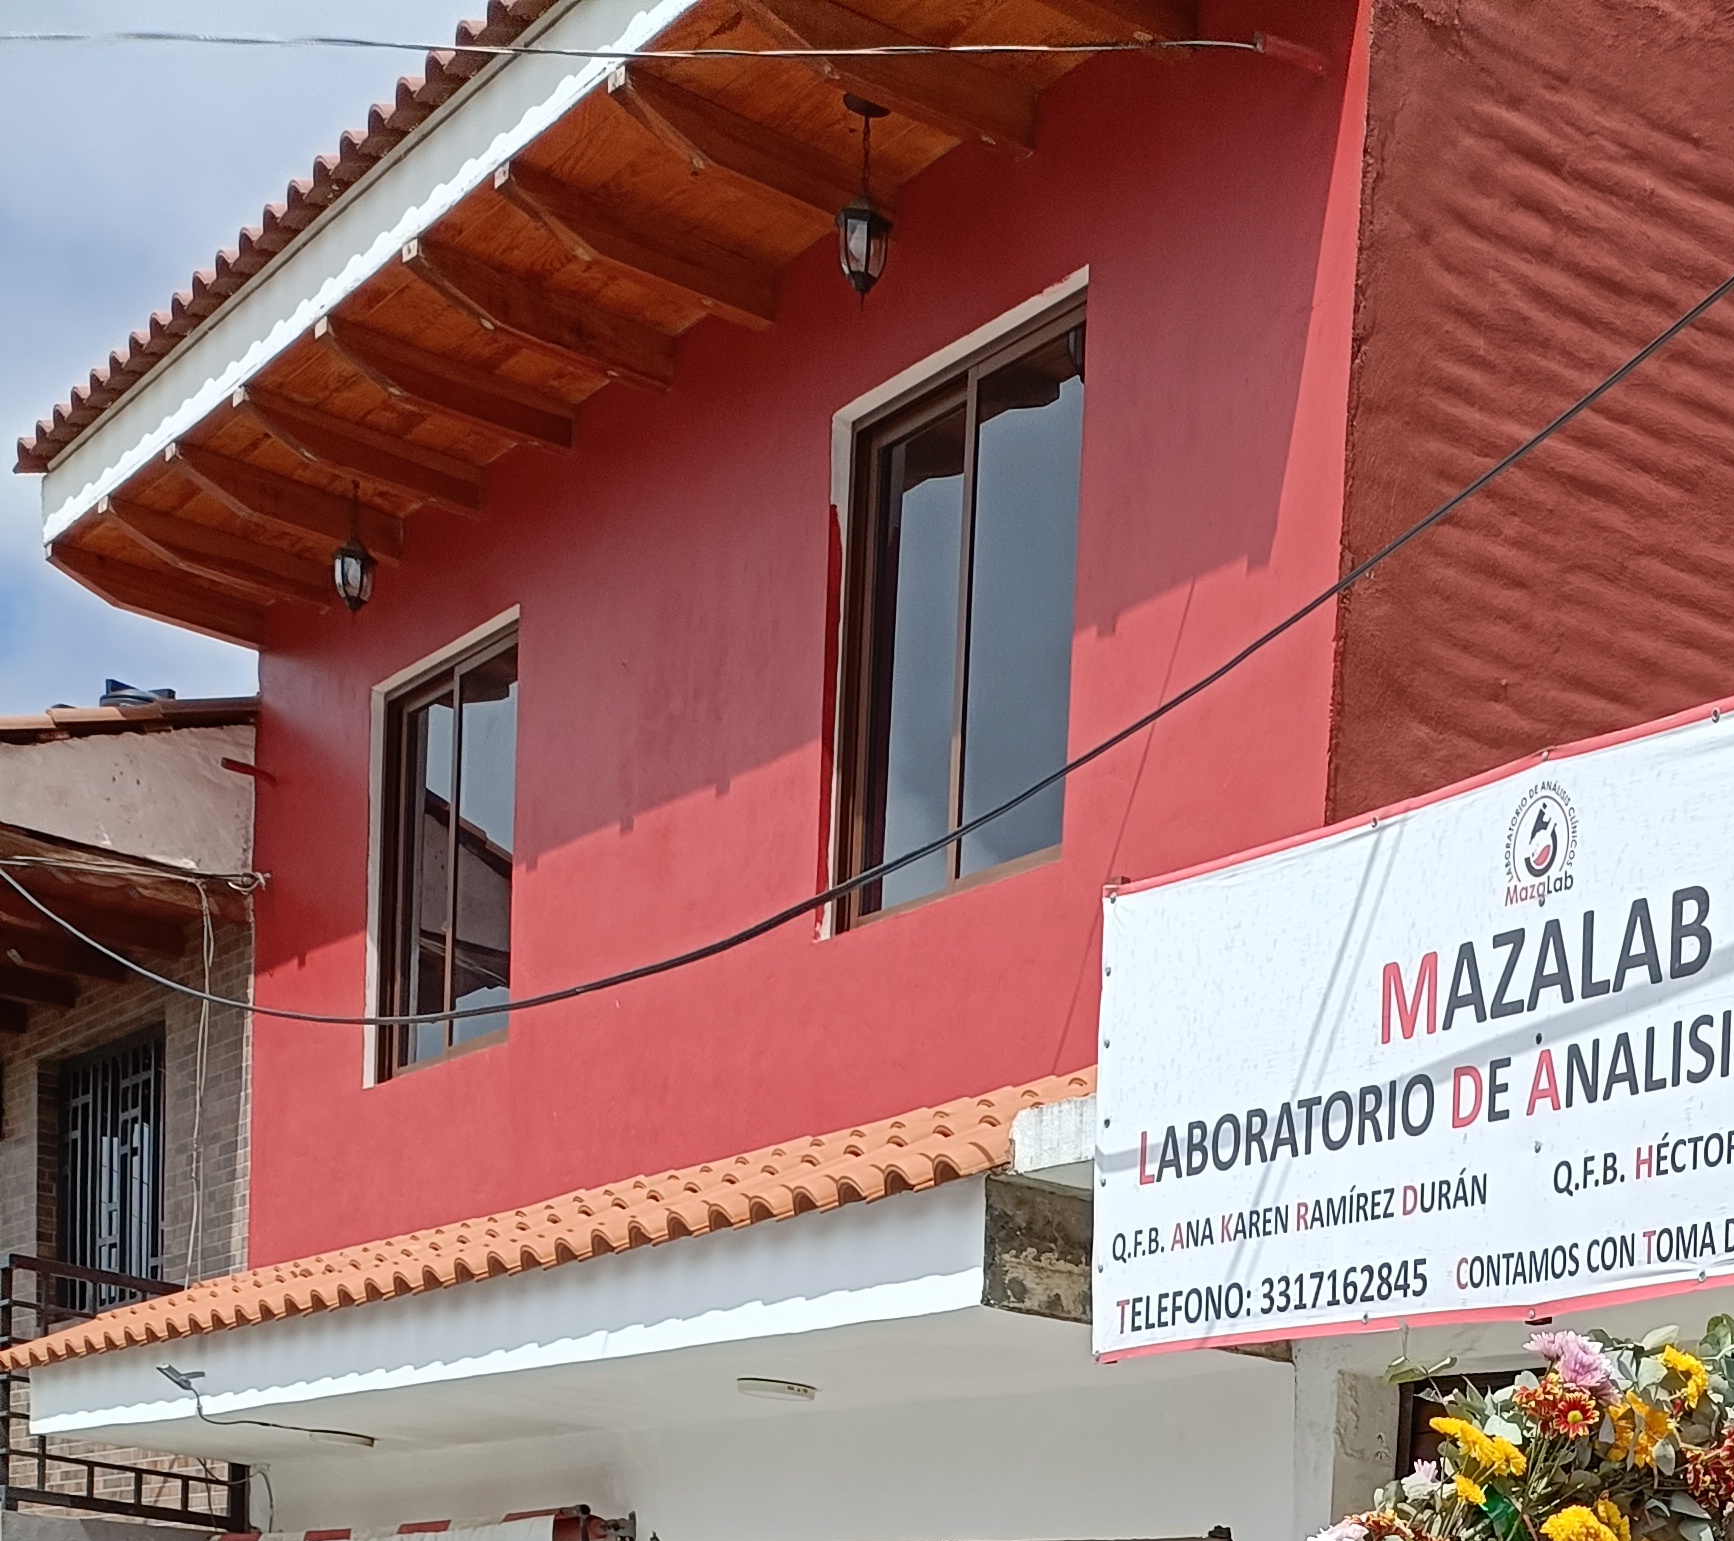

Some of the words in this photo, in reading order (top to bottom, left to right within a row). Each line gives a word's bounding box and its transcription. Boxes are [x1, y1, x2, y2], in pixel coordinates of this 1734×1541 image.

[1504, 797, 1528, 883] LABORATORIO
[1529, 784, 1539, 799] DE
[1381, 885, 1713, 1044] MAZALAB
[1138, 1073, 1435, 1186] LABORATORIO
[1451, 1057, 1511, 1128] DE
[1112, 1227, 1165, 1263] Q.F.B.
[1171, 1214, 1215, 1252] ANA
[1220, 1204, 1289, 1243] KAREN
[1295, 1184, 1395, 1232] RAMÍREZ
[1402, 1168, 1488, 1217] DURÁN
[1553, 1152, 1626, 1197] Q.F.B.
[1117, 1280, 1252, 1334] TELEFONO:
[1260, 1258, 1428, 1316] 3317162845
[1456, 1243, 1580, 1291] CONTAMOS
[1586, 1233, 1636, 1272] CON
[1643, 1224, 1716, 1265] TOMA
